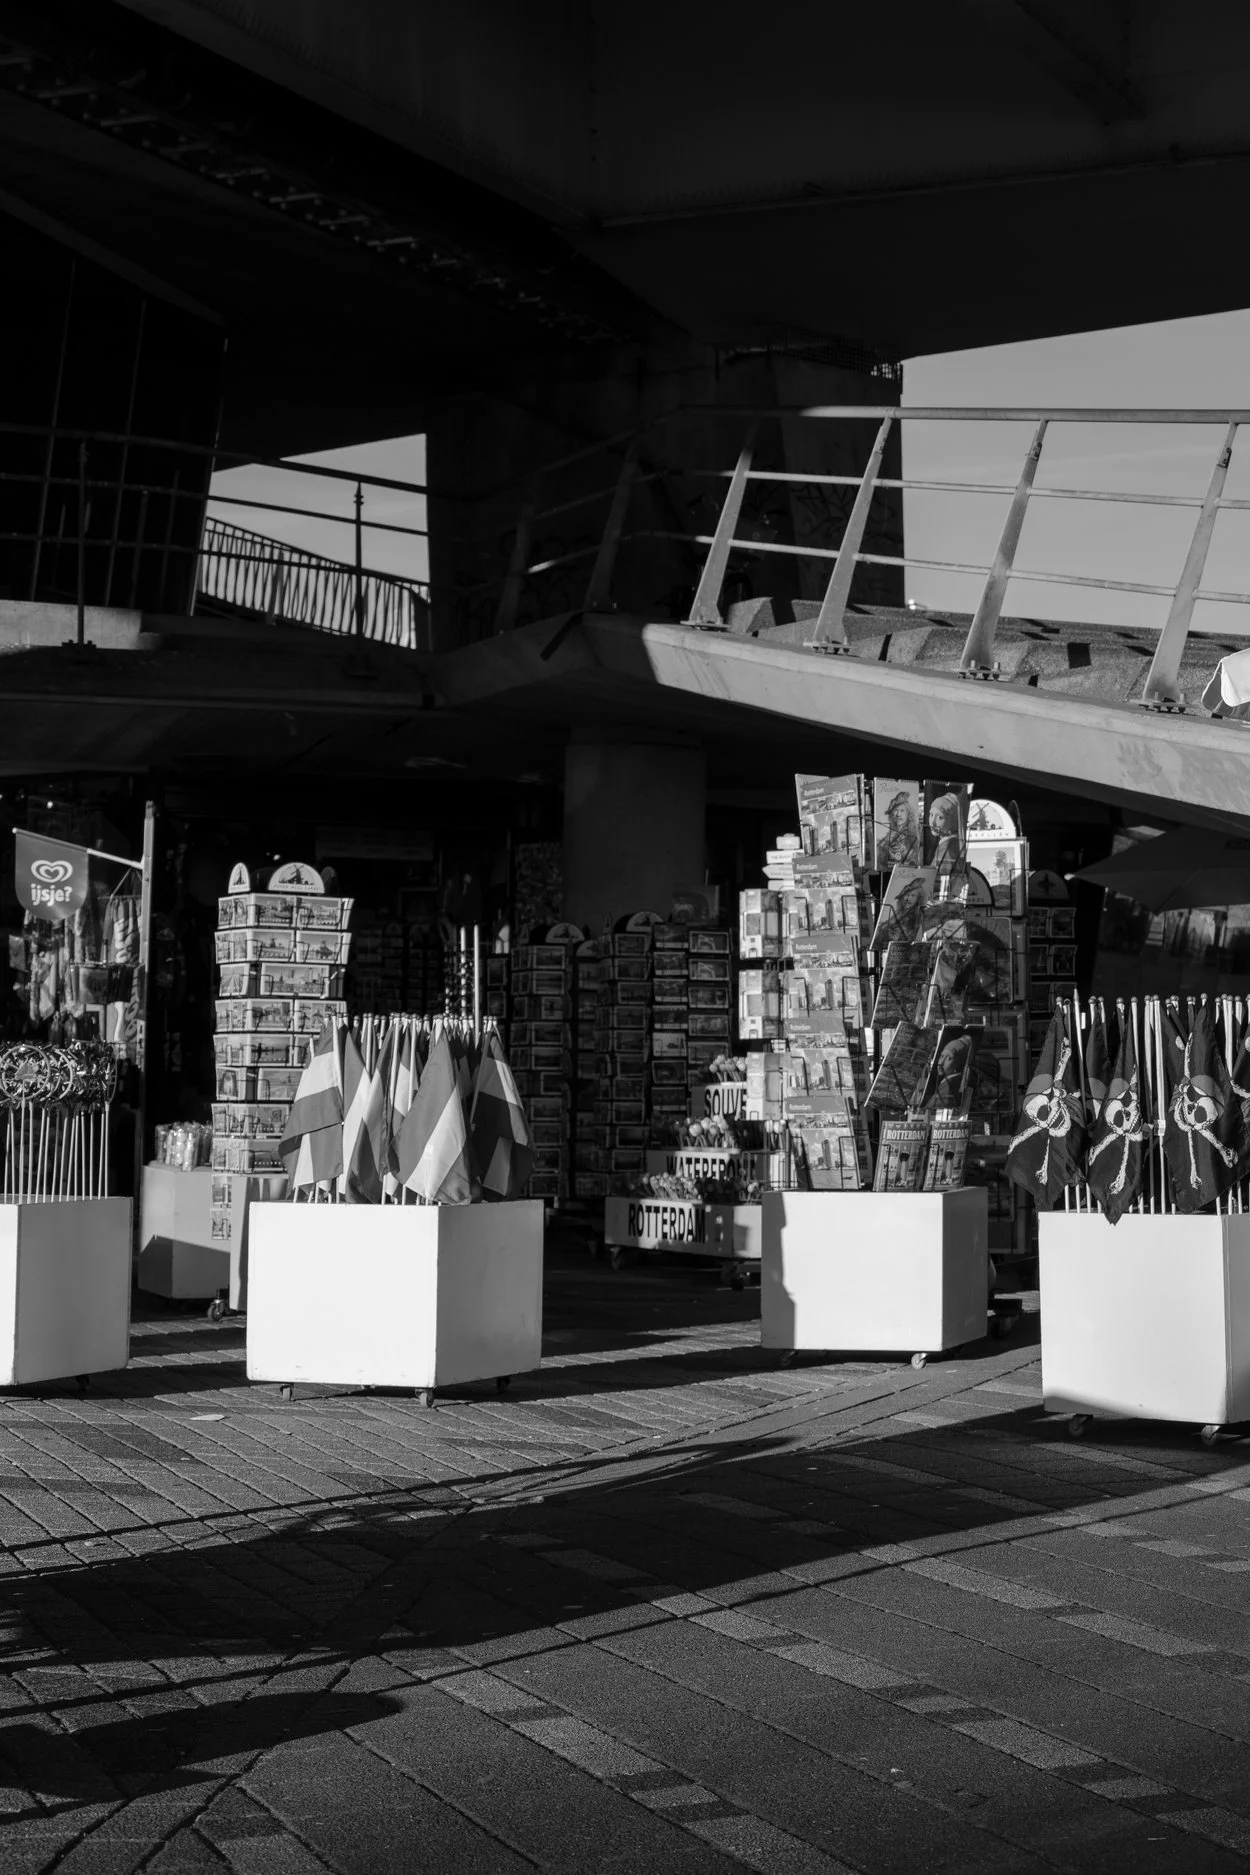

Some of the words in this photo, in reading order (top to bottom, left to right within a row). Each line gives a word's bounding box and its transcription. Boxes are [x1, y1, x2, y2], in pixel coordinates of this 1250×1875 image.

[31, 883, 73, 907] ijsje?
[886, 1129, 926, 1141] ROTTERDAM
[932, 1128, 969, 1140] ROTTERDAM
[628, 1203, 706, 1243] ROTTERDAM
